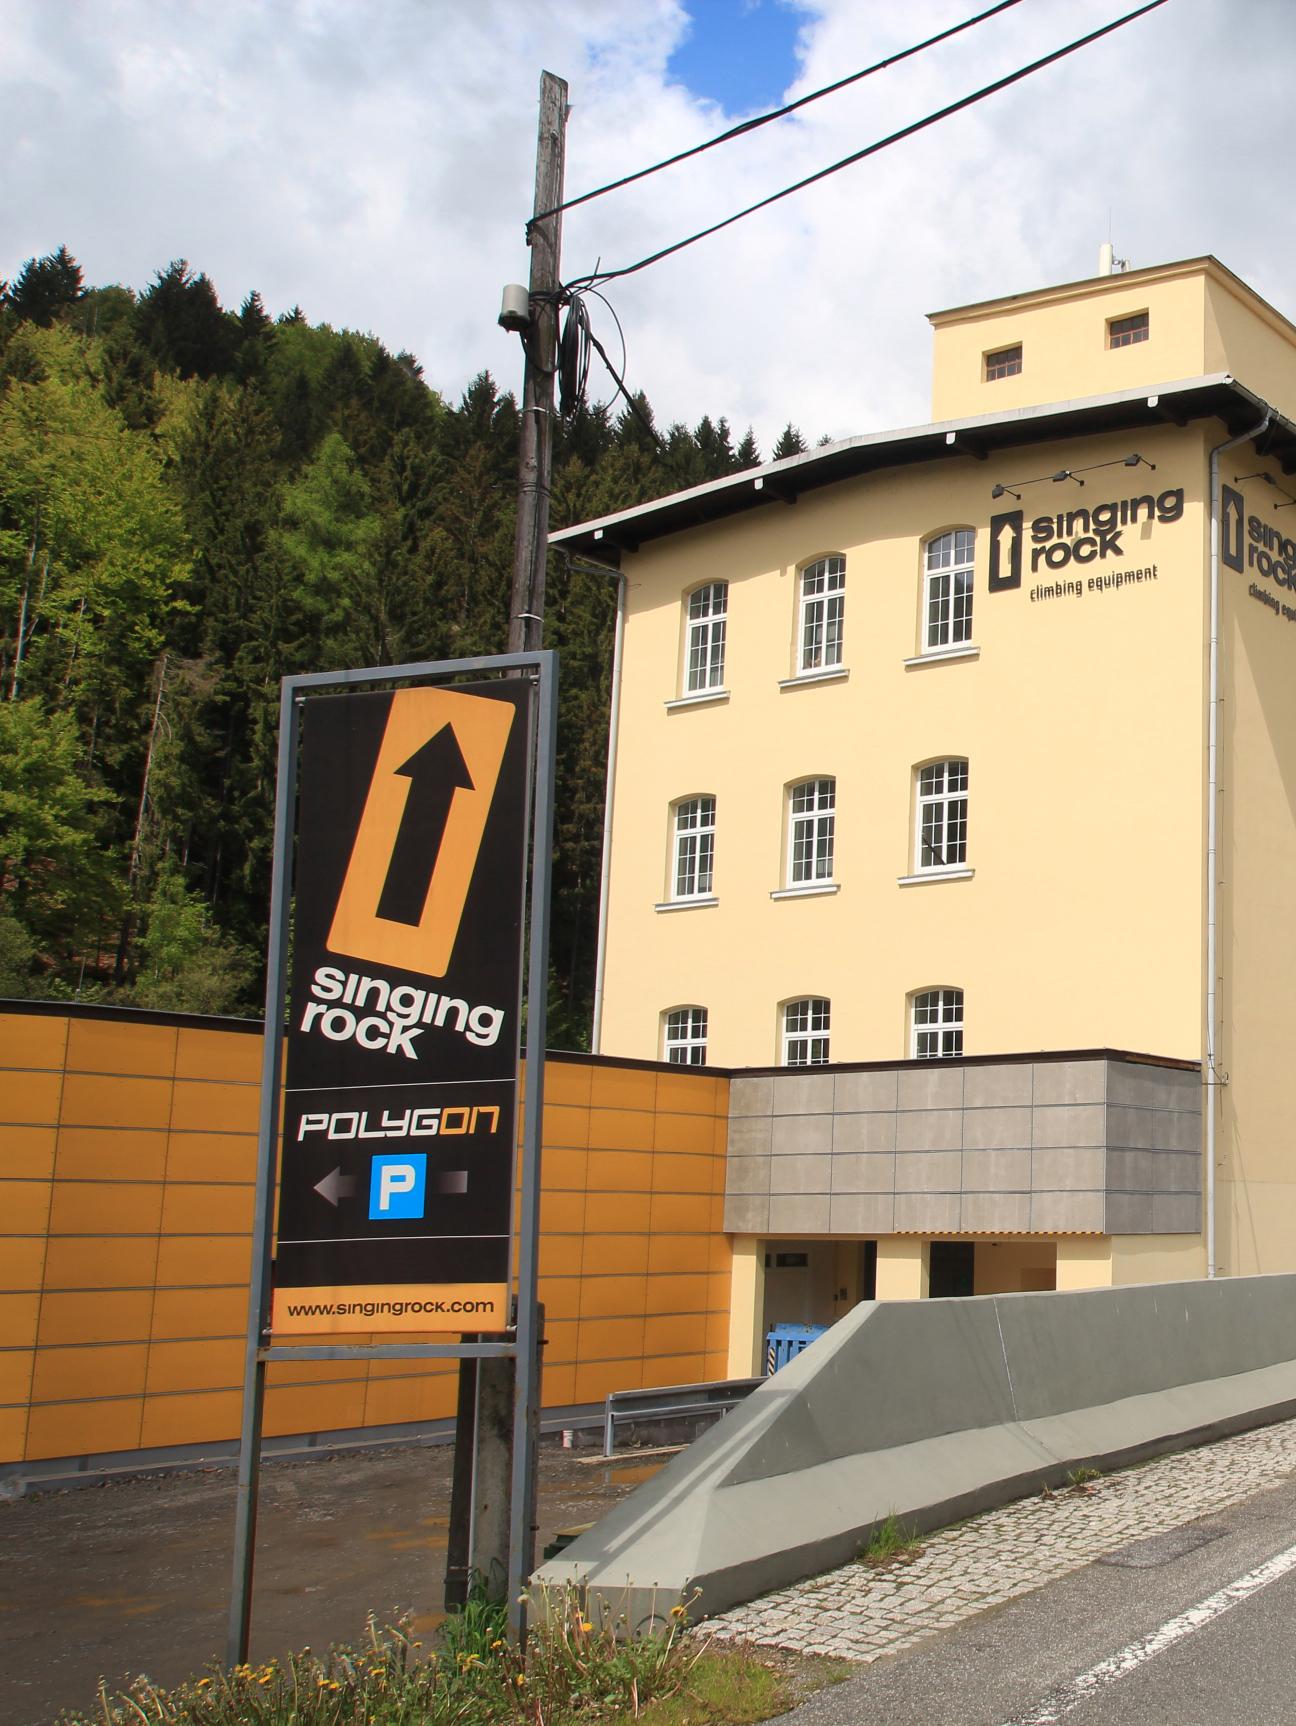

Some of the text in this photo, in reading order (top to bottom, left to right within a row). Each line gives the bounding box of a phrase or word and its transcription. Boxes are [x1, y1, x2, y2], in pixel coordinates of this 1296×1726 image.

[1031, 488, 1185, 544] singing
[1031, 530, 1124, 573] rock
[1030, 564, 1158, 602] climbing equipment
[1248, 582, 1280, 616] climbing
[310, 966, 505, 1047] singing
[300, 1002, 425, 1060] rock
[297, 1105, 500, 1142] POLYGON
[379, 1164, 416, 1210] P
[287, 1300, 495, 1317] www.singingrock.com
